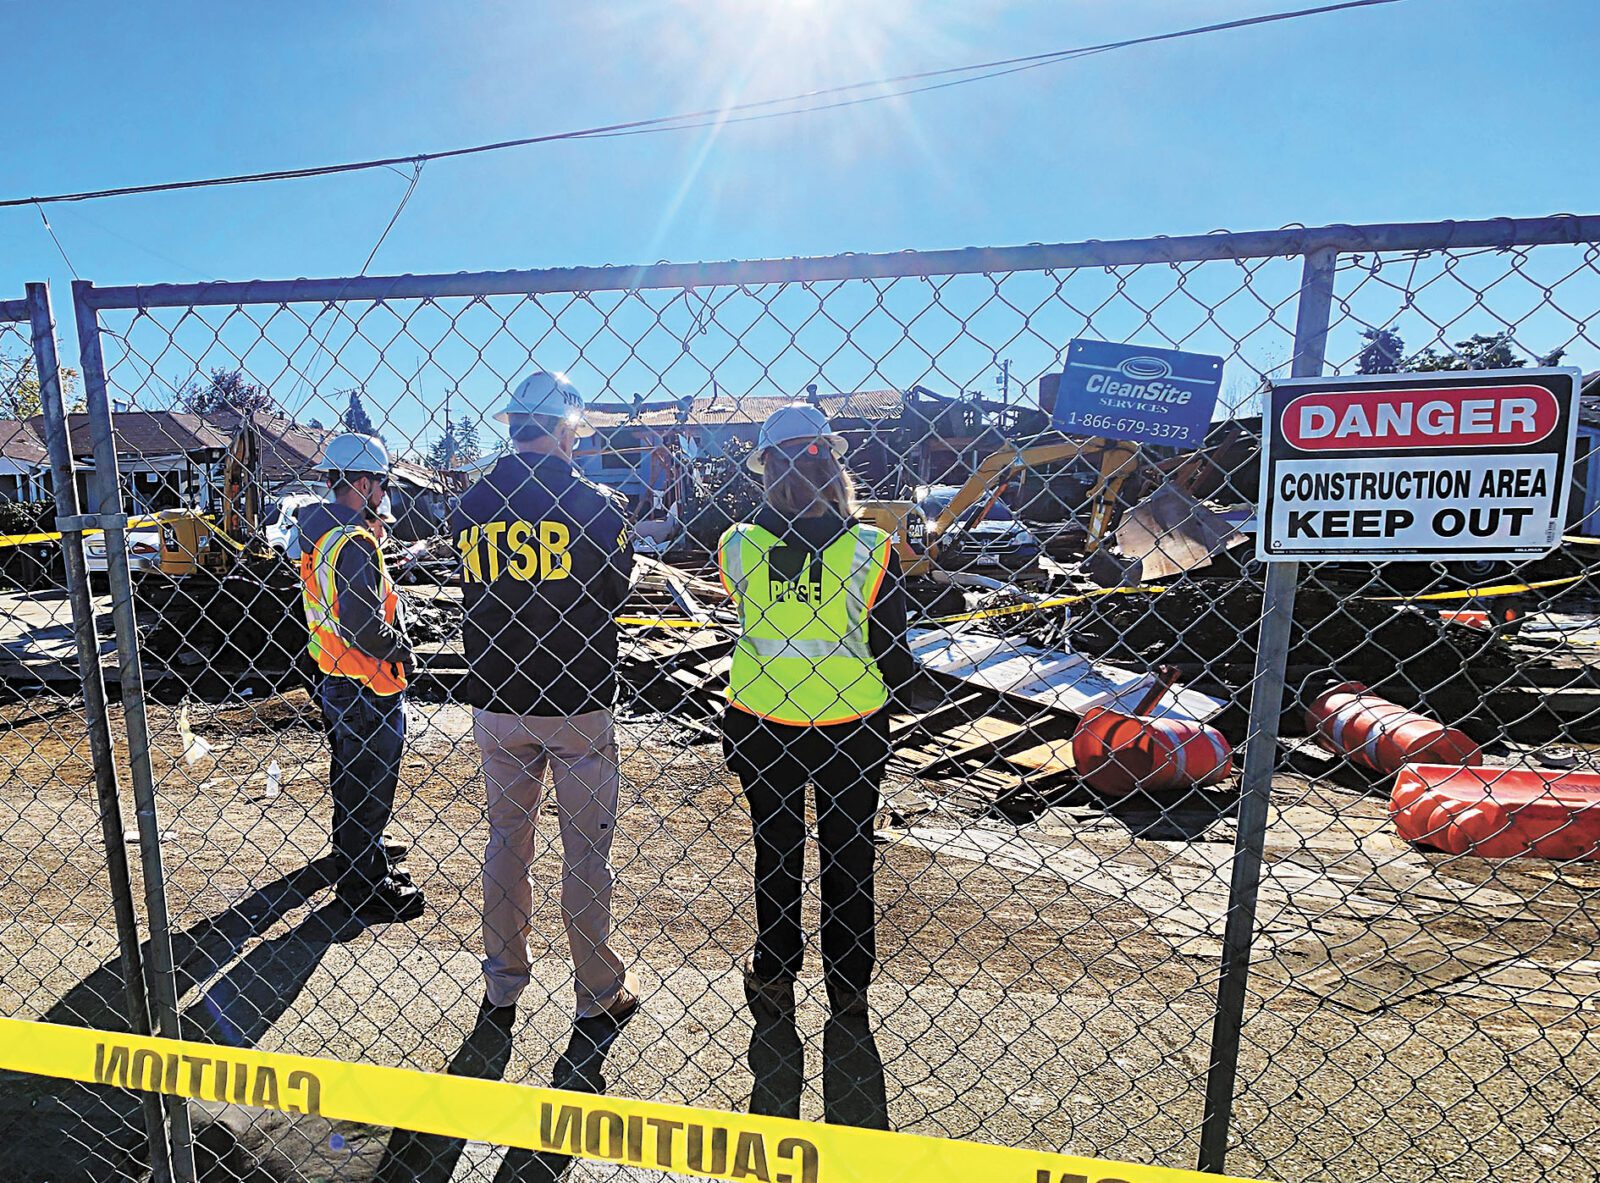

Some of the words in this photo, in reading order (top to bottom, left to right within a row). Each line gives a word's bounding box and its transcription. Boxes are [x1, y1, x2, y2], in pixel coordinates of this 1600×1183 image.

[1086, 373, 1192, 405] CleanSite
[1099, 397, 1169, 414] SERVICES
[1299, 398, 1538, 440] DANGER
[1068, 411, 1189, 440] 1-866-679-3373
[1280, 469, 1471, 502] CONSTRUCTION
[1478, 468, 1547, 499] AREA
[1287, 509, 1414, 539] KEEP
[1431, 507, 1534, 538] OUT
[457, 520, 572, 583] NTSB
